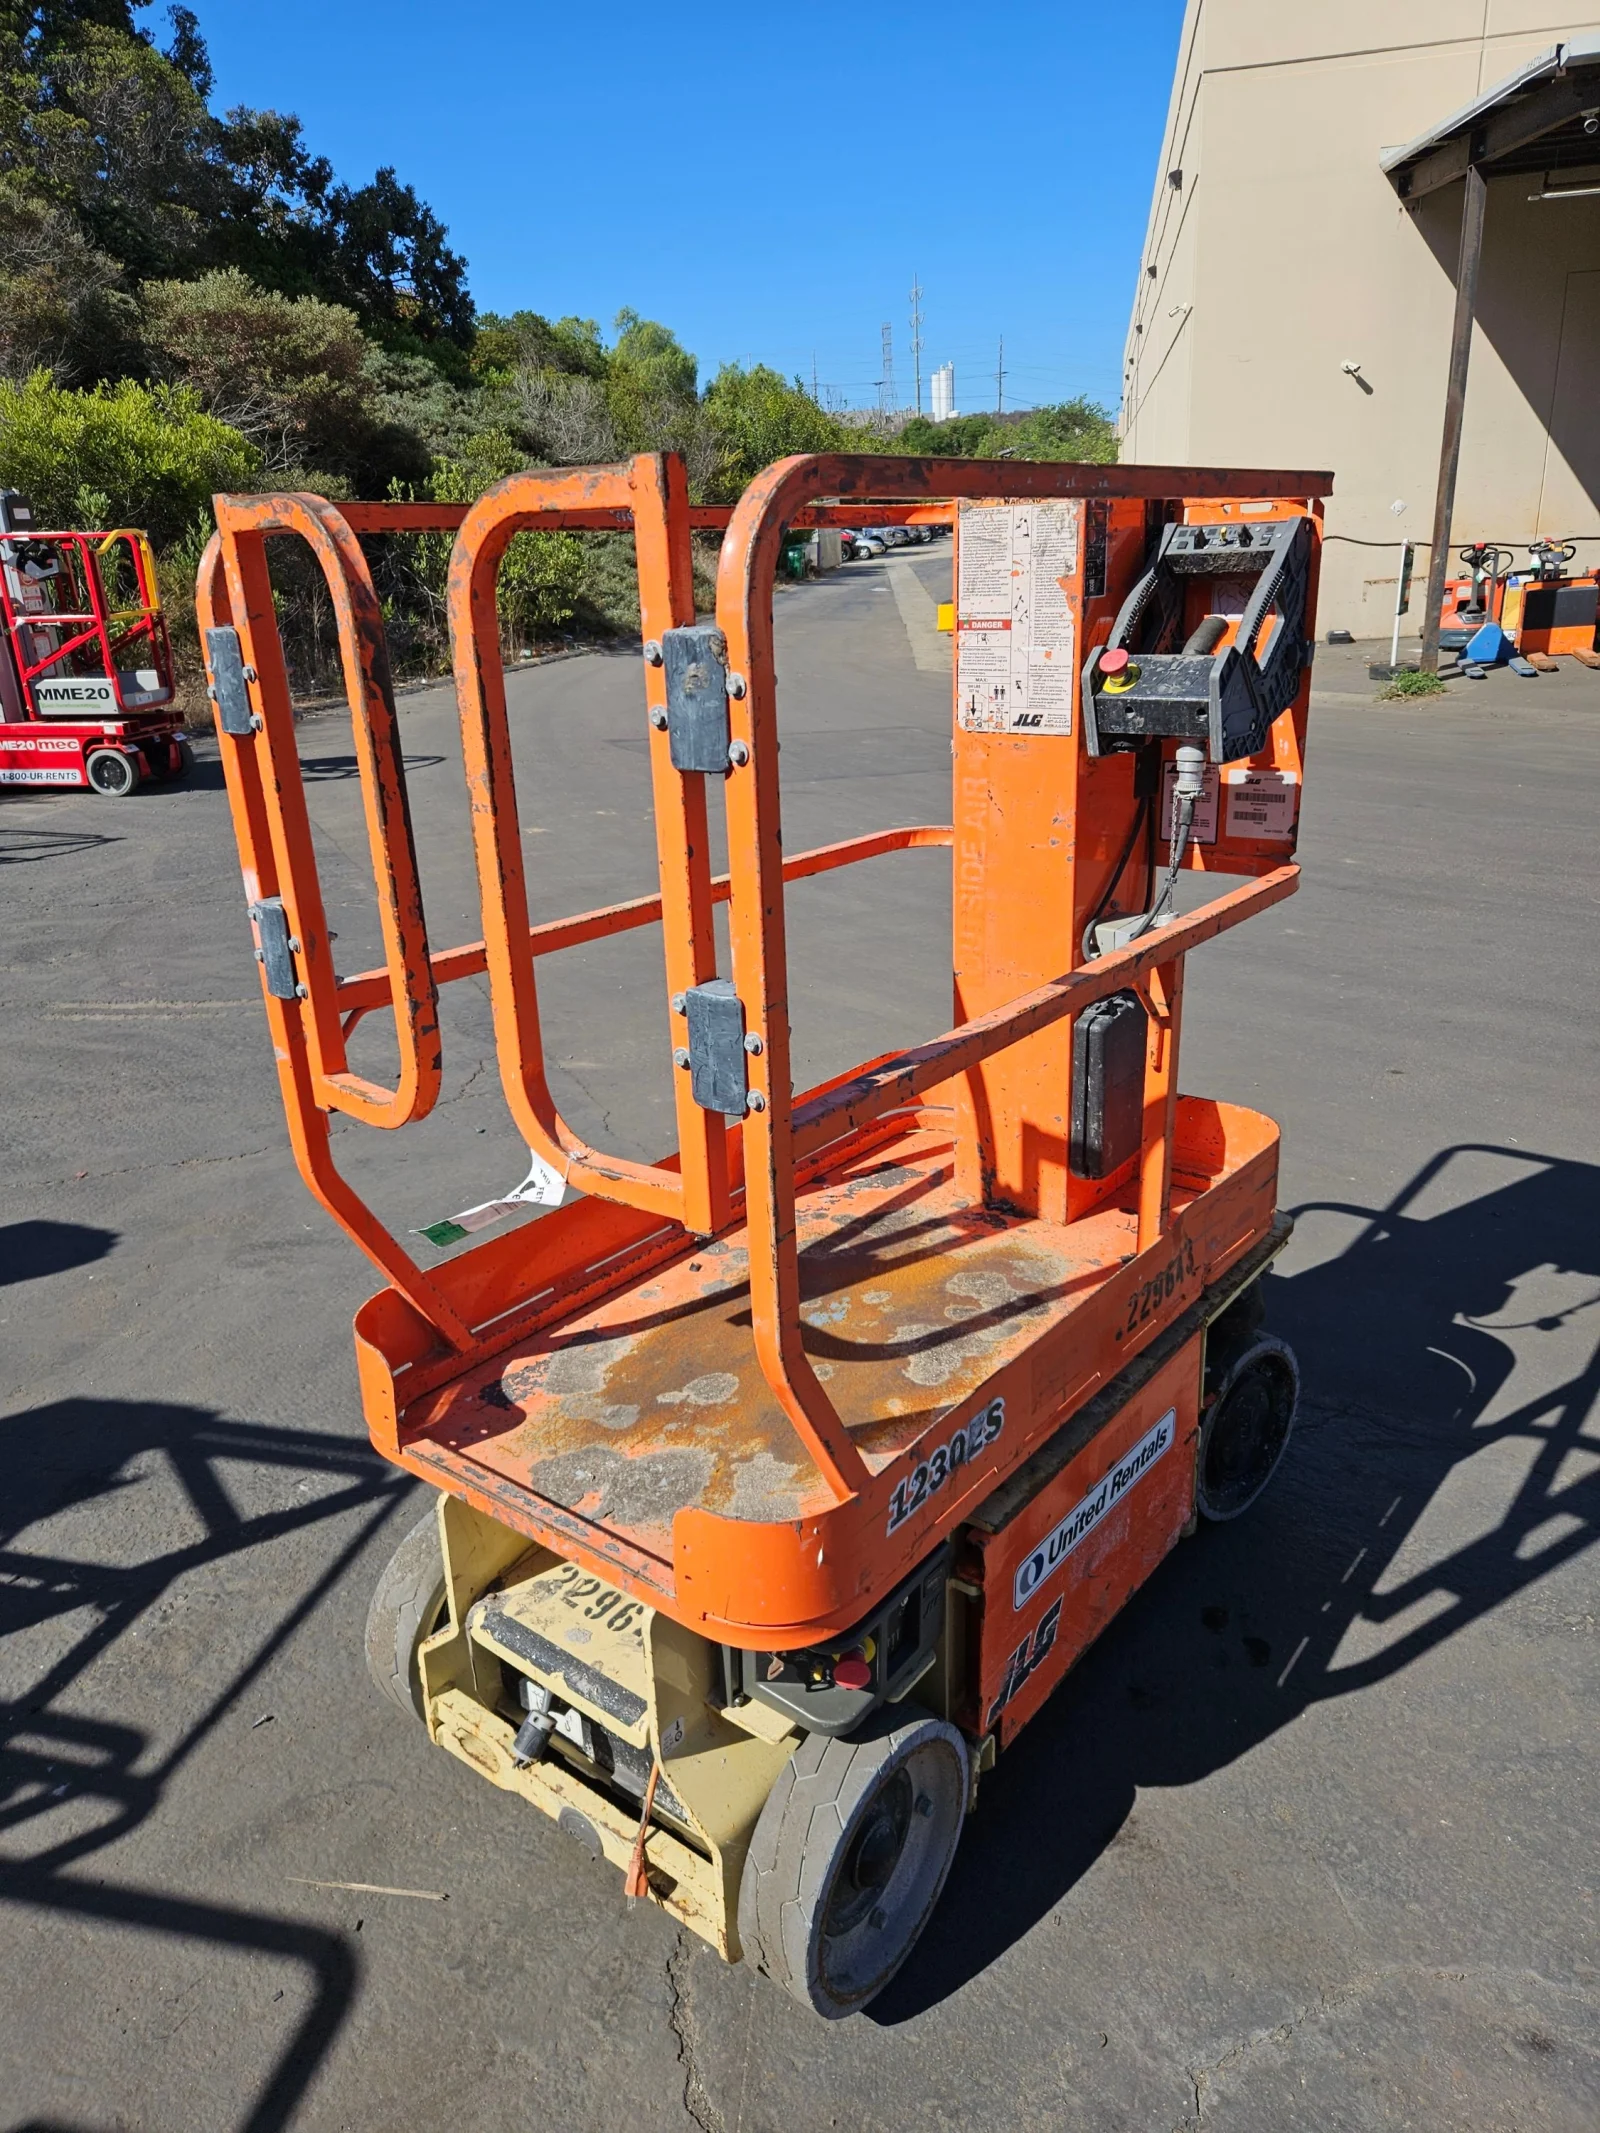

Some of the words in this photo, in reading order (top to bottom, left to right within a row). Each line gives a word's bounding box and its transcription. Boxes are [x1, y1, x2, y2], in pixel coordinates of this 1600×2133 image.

[971, 621, 1003, 629] DANGER
[36, 687, 110, 701] MME20
[1012, 713, 1044, 727] JLG
[38, 741, 79, 750] mec
[1, 771, 78, 781] 1-800-UR-RENTS
[1047, 1482, 1108, 1565] United
[1110, 1427, 1169, 1500] Rentals
[549, 1565, 645, 1648] 2296
[986, 1591, 1065, 1727] JLG
